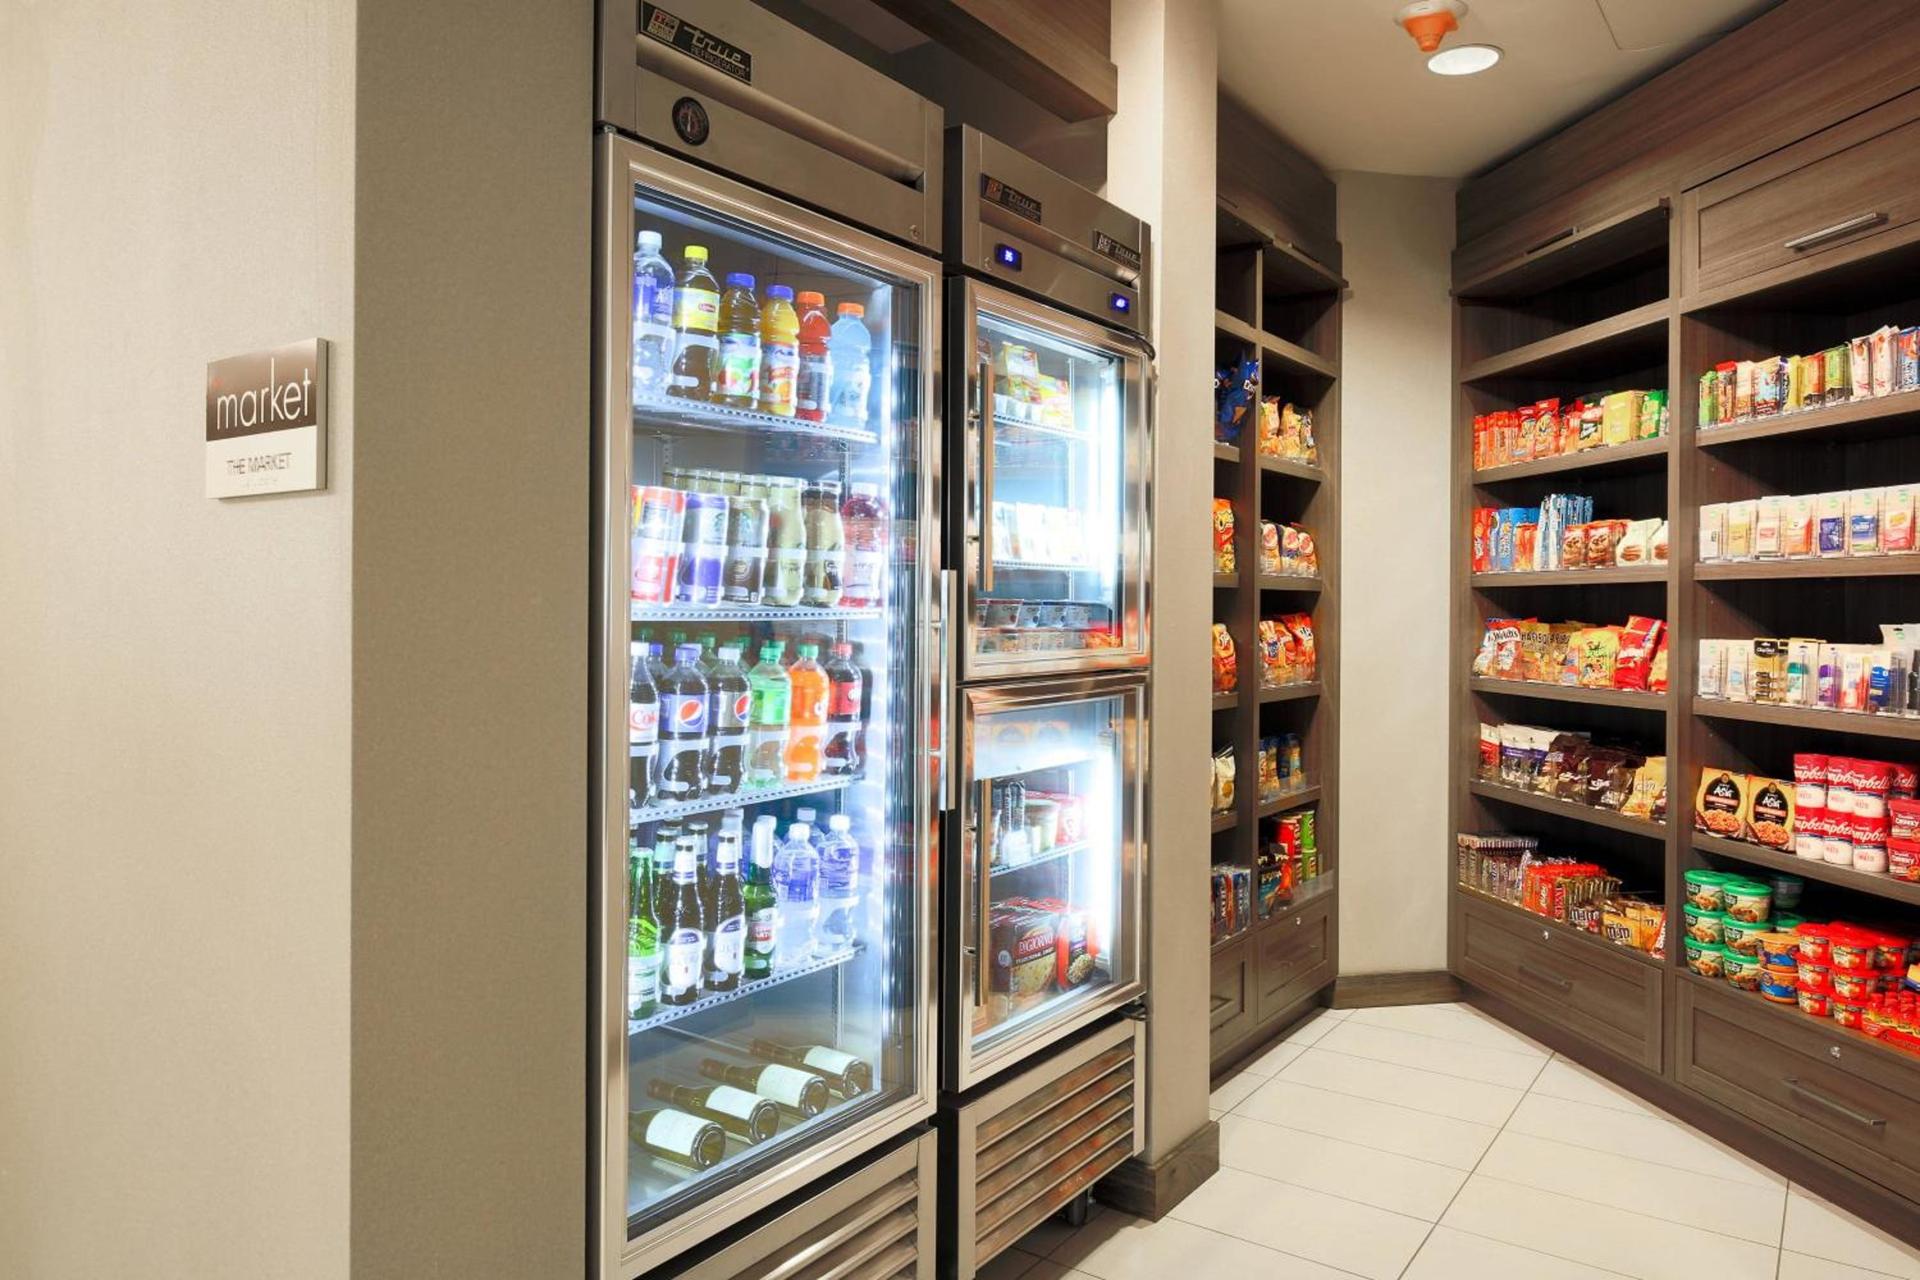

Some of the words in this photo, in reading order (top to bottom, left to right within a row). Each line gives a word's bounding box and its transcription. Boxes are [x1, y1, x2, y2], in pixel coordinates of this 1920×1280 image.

[683, 26, 746, 69] true
[217, 357, 312, 431] market
[226, 457, 246, 476] THE
[248, 452, 292, 474] MARKET
